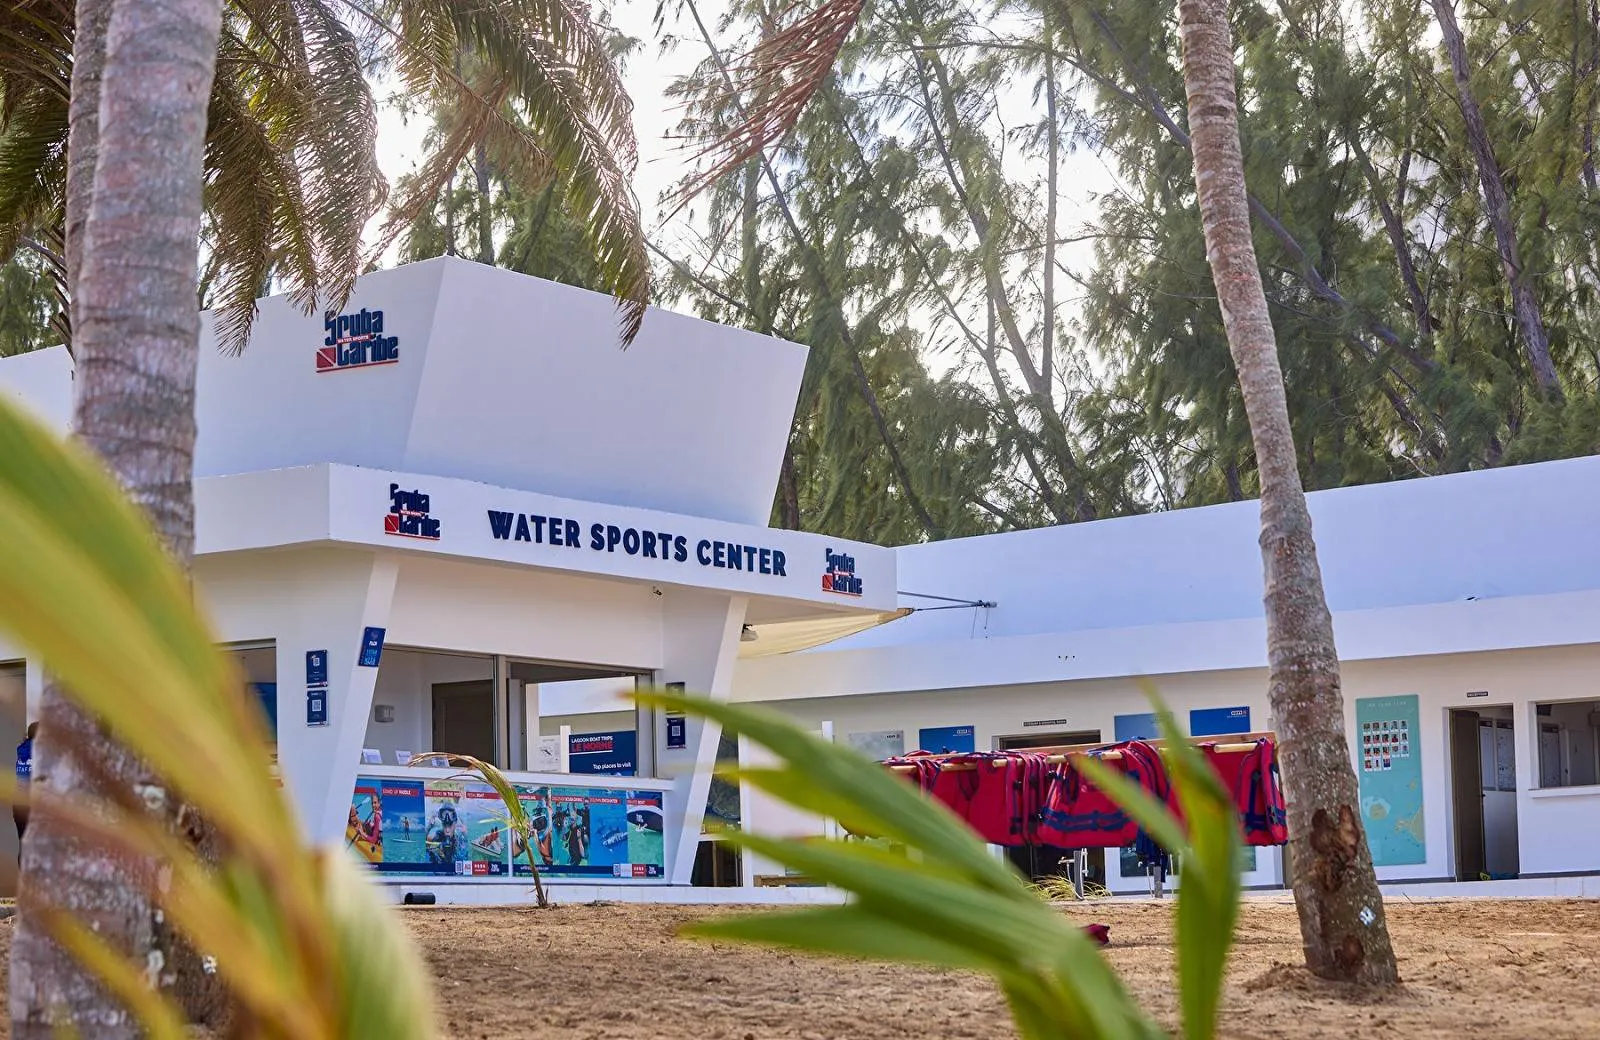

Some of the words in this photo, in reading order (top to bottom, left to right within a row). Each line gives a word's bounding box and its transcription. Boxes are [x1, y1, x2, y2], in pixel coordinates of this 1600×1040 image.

[324, 308, 384, 346] Scuba
[337, 334, 399, 366] Caribe
[390, 483, 430, 513] Scuba
[487, 509, 581, 548] WATER
[590, 523, 688, 562] SPORTS
[696, 539, 787, 577] CENTER
[571, 744, 582, 752] LE
